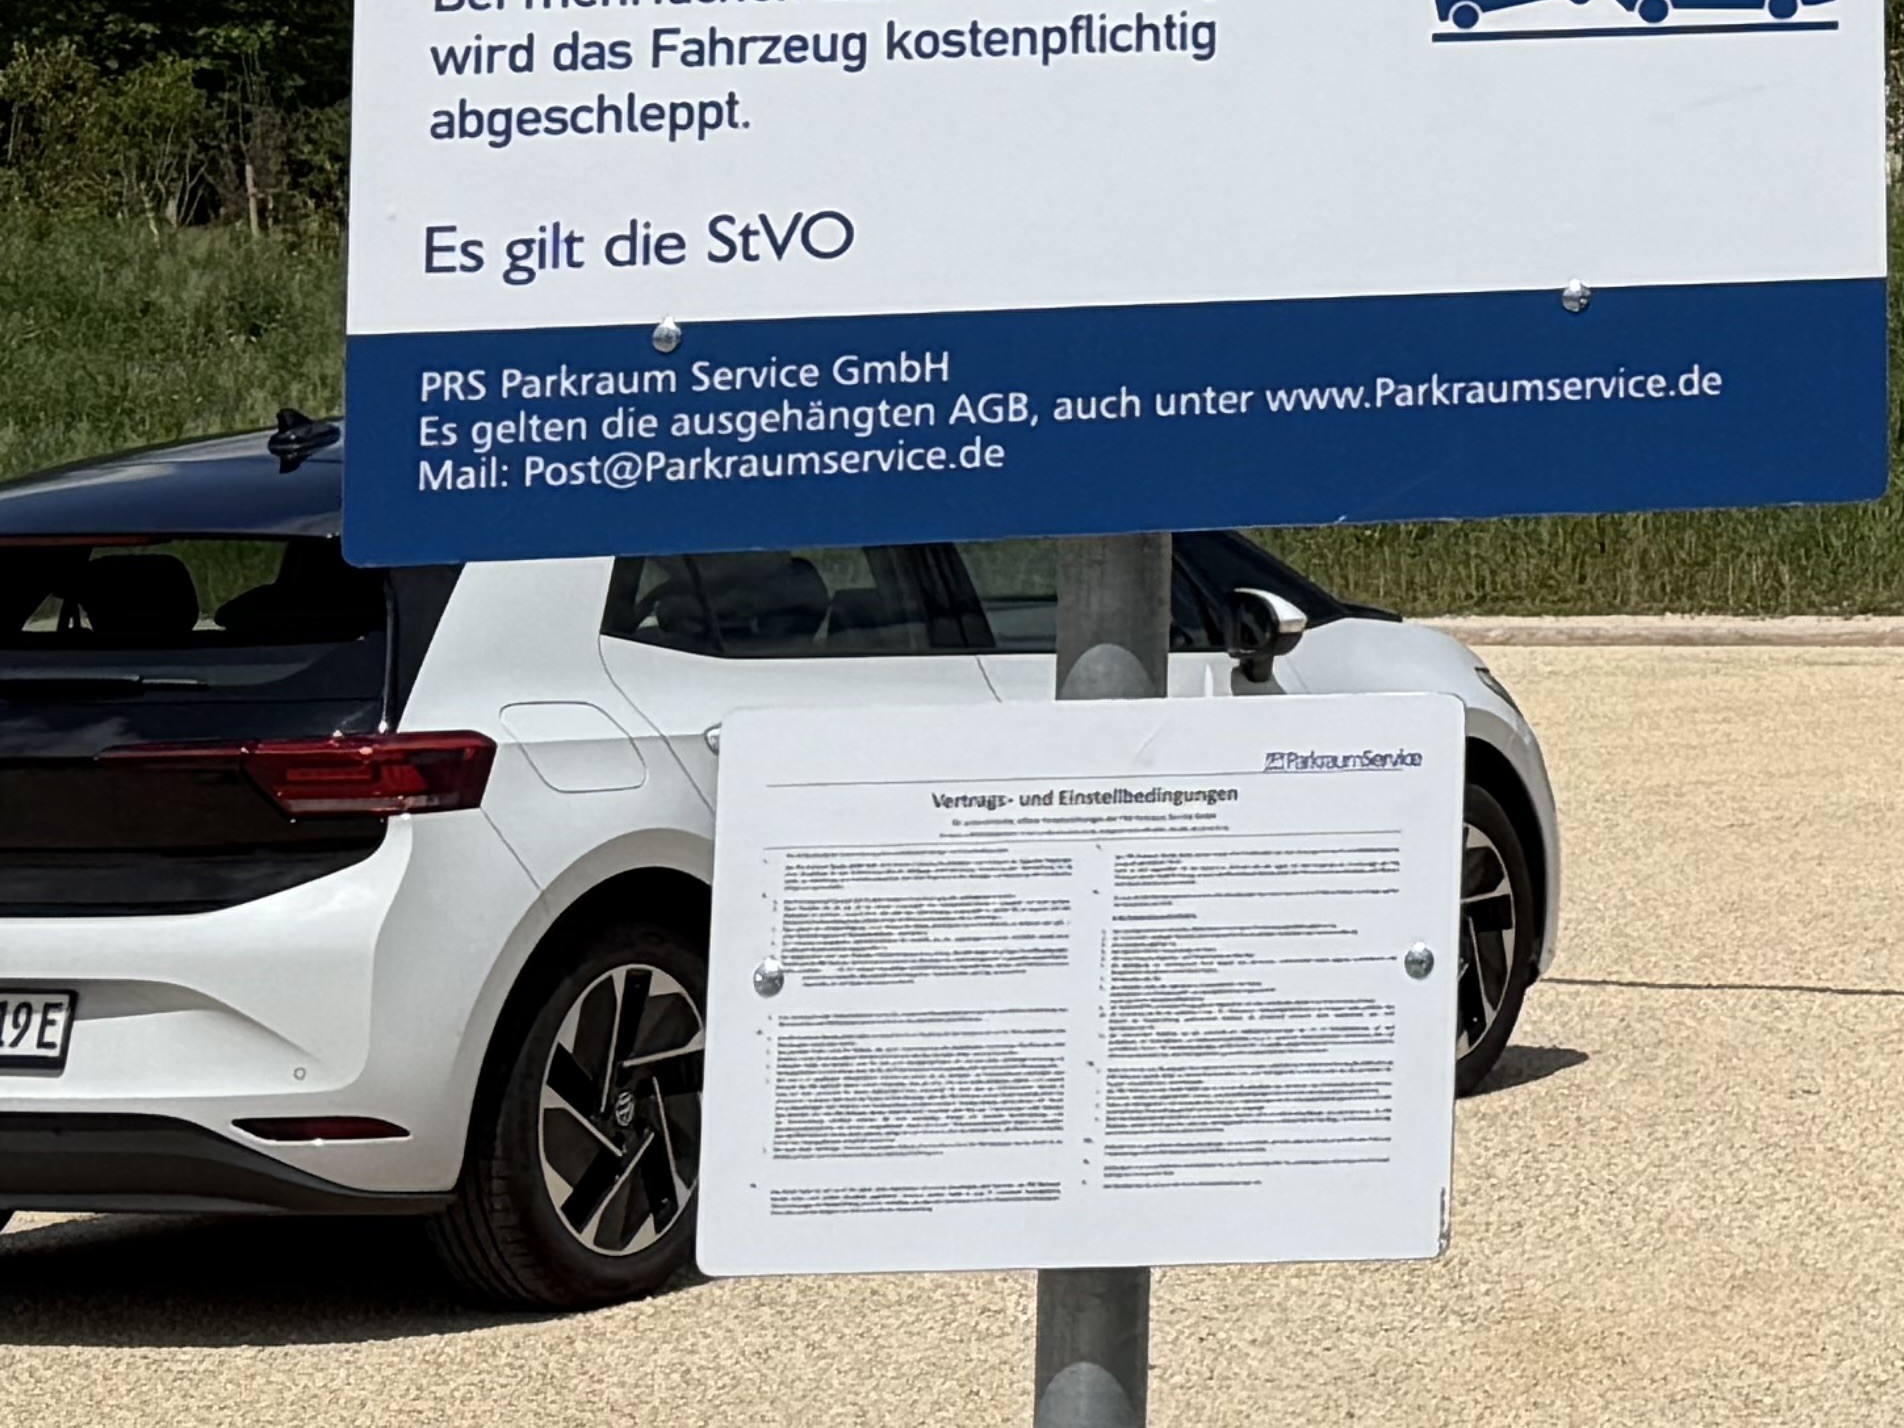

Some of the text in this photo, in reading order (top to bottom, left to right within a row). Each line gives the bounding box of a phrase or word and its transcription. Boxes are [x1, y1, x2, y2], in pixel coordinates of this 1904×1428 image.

[430, 10, 1216, 76] wird das Fahrzeug kostenpflichtig
[430, 91, 750, 149] abgeschleppt.
[424, 210, 855, 286] Es gilt die StVO
[421, 350, 949, 402] PRS Parkraum Service GmbH
[420, 363, 1722, 454] Es gelten die ausgehängten AGB, auch unter www.Parkraumservice.de
[418, 435, 1005, 491] Mail: Post@Parkraumservice.de
[931, 786, 1239, 812] Vertrags- und Einstellbedingungen
